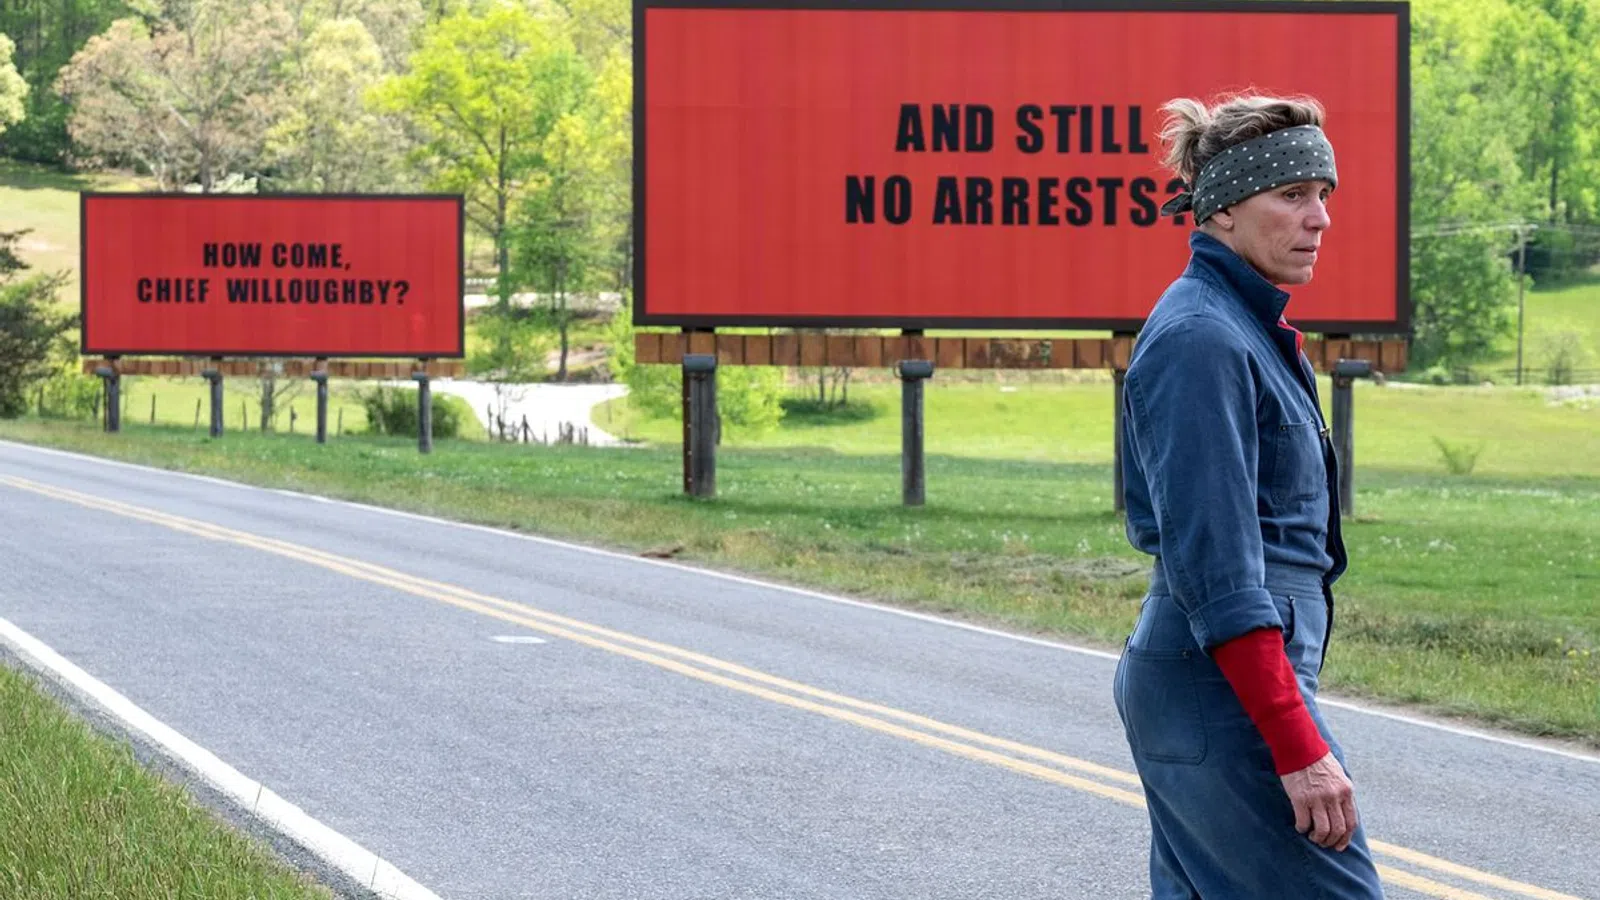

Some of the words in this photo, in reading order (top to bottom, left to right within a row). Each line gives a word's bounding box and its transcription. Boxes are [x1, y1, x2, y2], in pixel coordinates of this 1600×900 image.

[896, 103, 993, 154] AND
[1016, 104, 1148, 154] STILL
[845, 175, 911, 225] NO
[203, 242, 261, 268] HOW
[271, 242, 350, 271] COME,
[136, 278, 209, 303] CHIEF
[227, 279, 410, 305] WILLOUGHBY?
